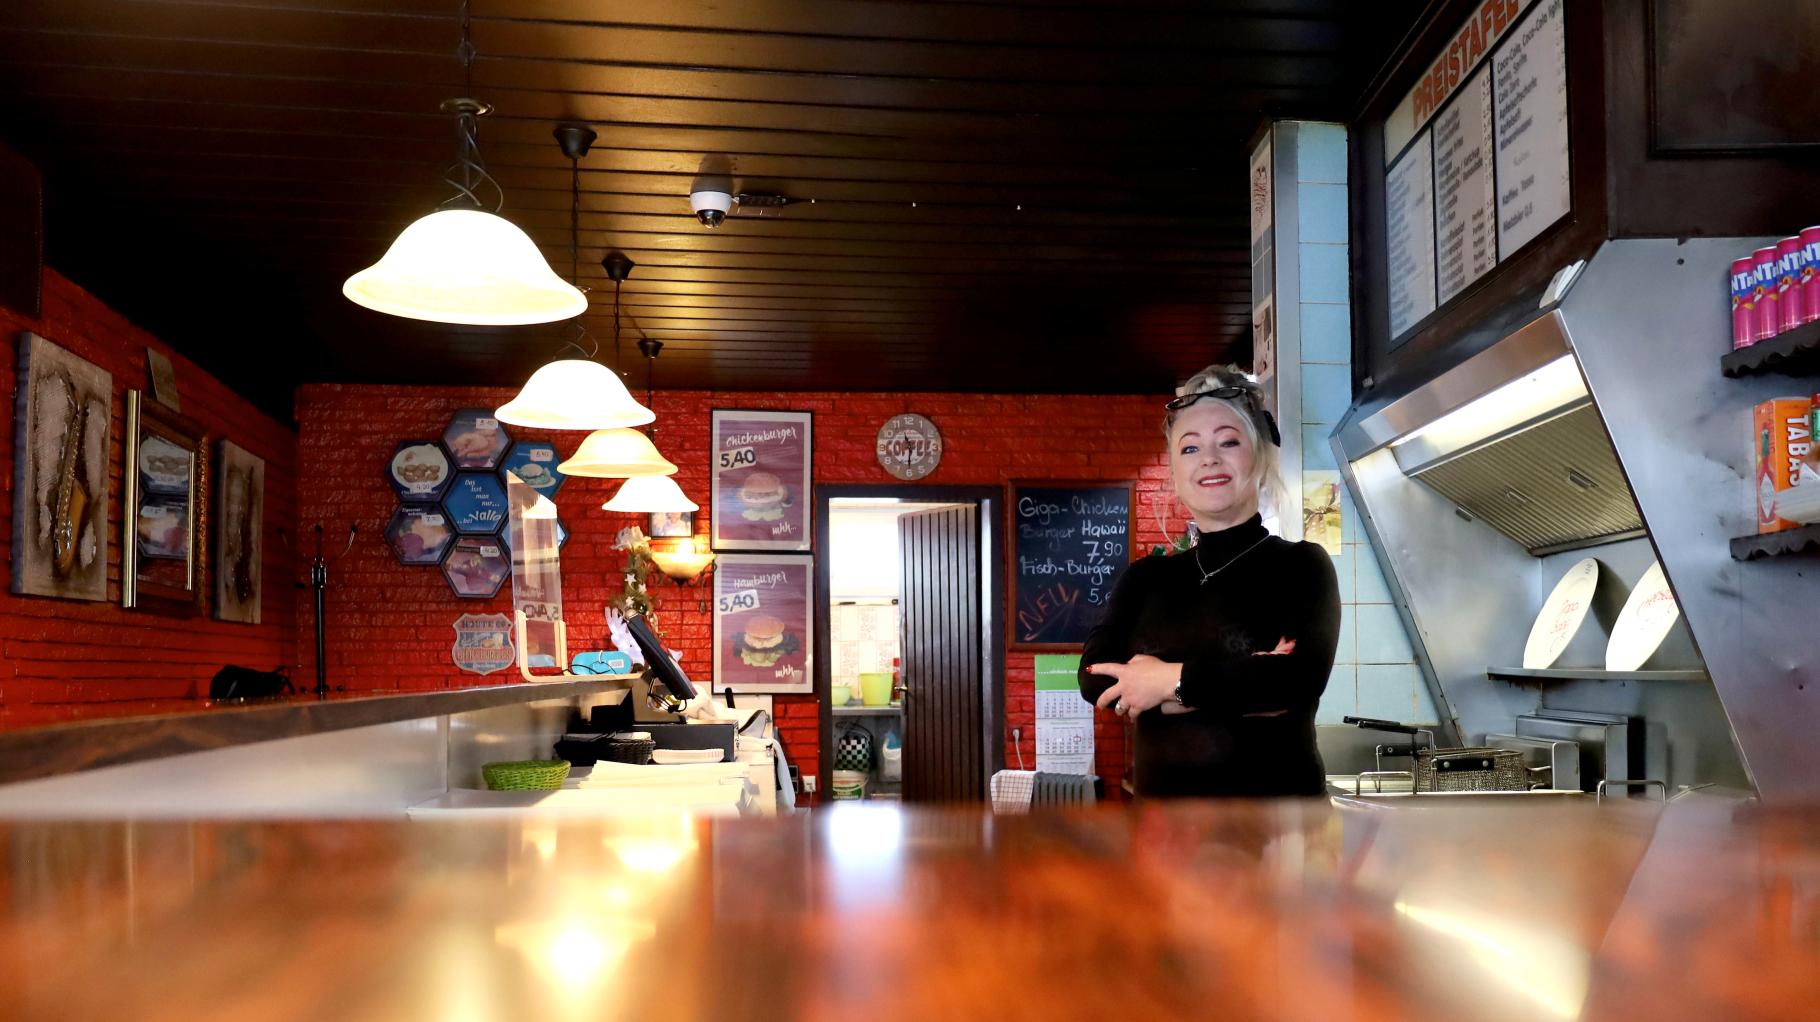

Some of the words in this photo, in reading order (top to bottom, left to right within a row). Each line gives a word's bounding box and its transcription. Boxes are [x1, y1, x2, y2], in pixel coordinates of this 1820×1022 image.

[720, 449, 756, 469] 5,40
[1071, 495, 1129, 516] Chicken
[1081, 519, 1126, 538] Hawaii
[1082, 541, 1123, 566] 7,90
[719, 593, 755, 613] 5,40
